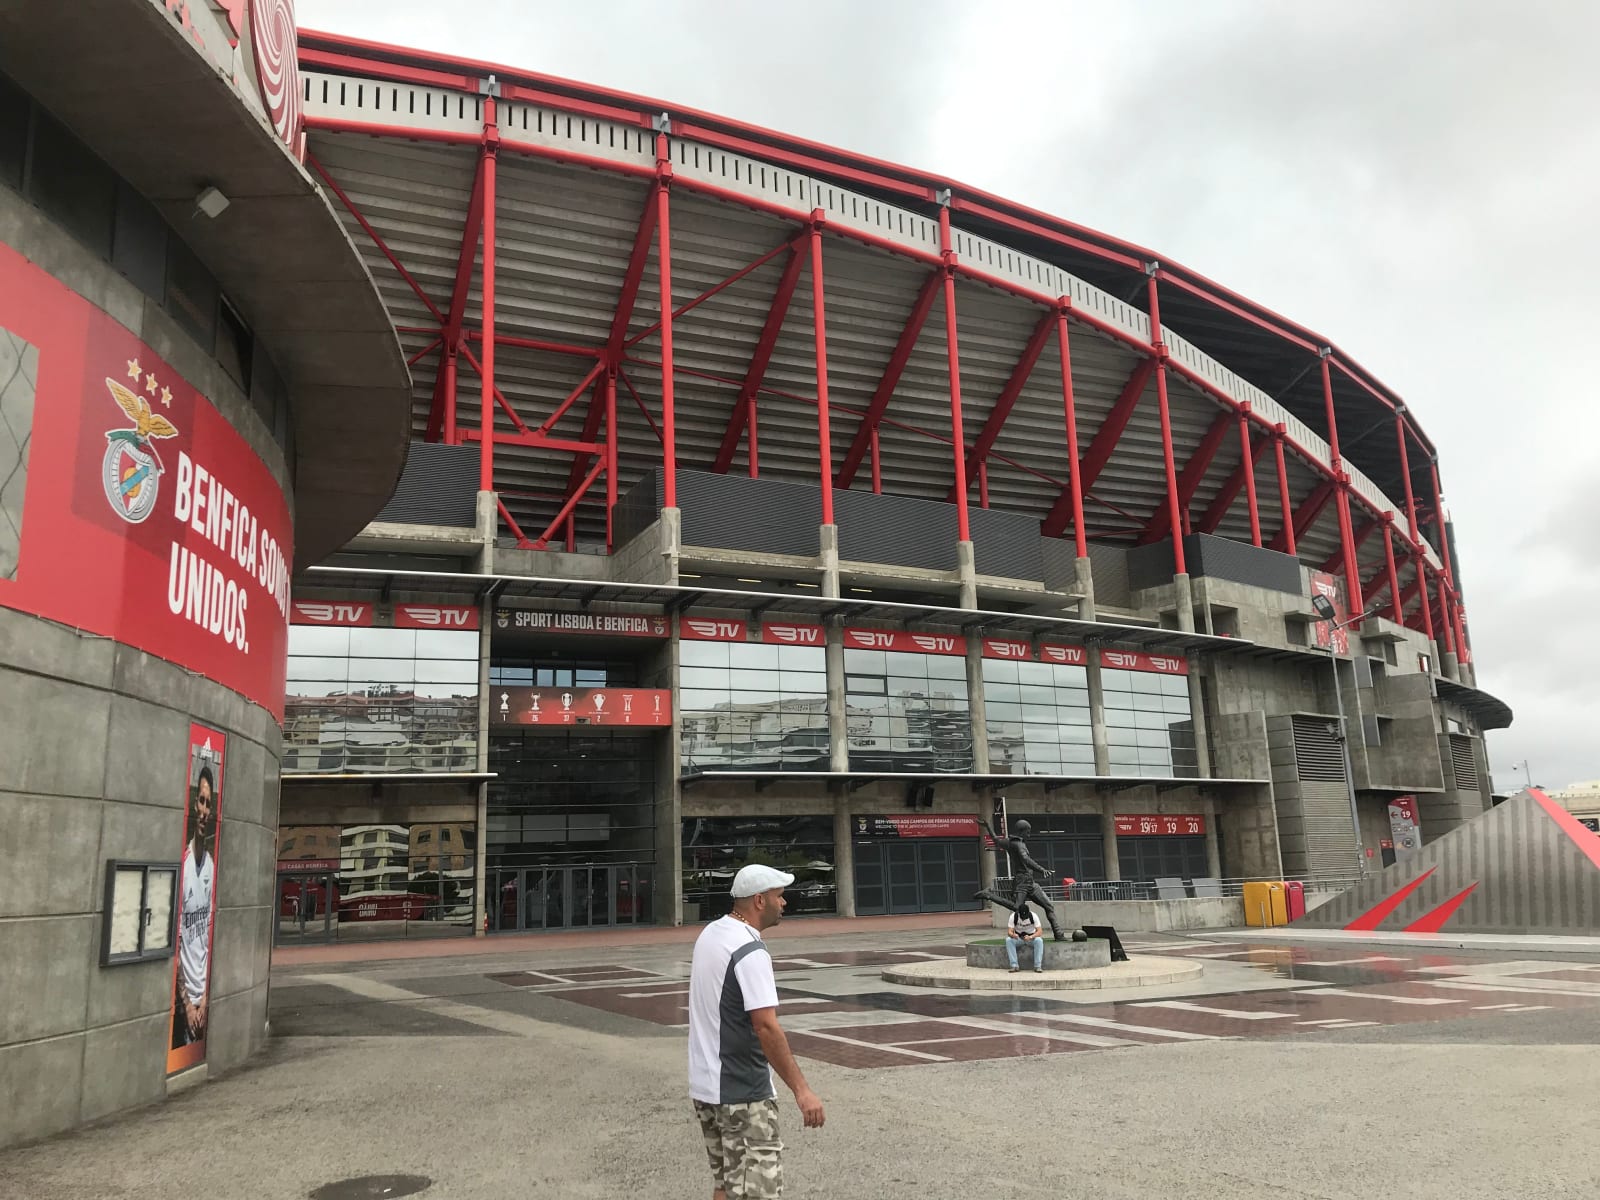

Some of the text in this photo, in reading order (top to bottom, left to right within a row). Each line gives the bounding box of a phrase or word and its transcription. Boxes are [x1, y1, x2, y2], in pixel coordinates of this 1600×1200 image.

[174, 450, 257, 578] BENFICA
[168, 541, 249, 654] UNIDOS.
[296, 604, 364, 622] BTV
[404, 608, 469, 625] BTV
[515, 611, 648, 632] SPORT LISBOA E BENFICA
[687, 621, 739, 637] BTV
[769, 626, 818, 641] BTV
[849, 631, 894, 647] BTV
[912, 635, 954, 651] BTV
[987, 641, 1026, 656] BTV
[1045, 647, 1081, 661] BTV
[1105, 652, 1137, 666] BTV
[1149, 656, 1179, 671] BTV
[1166, 822, 1177, 833] 19
[1188, 822, 1199, 833] 20
